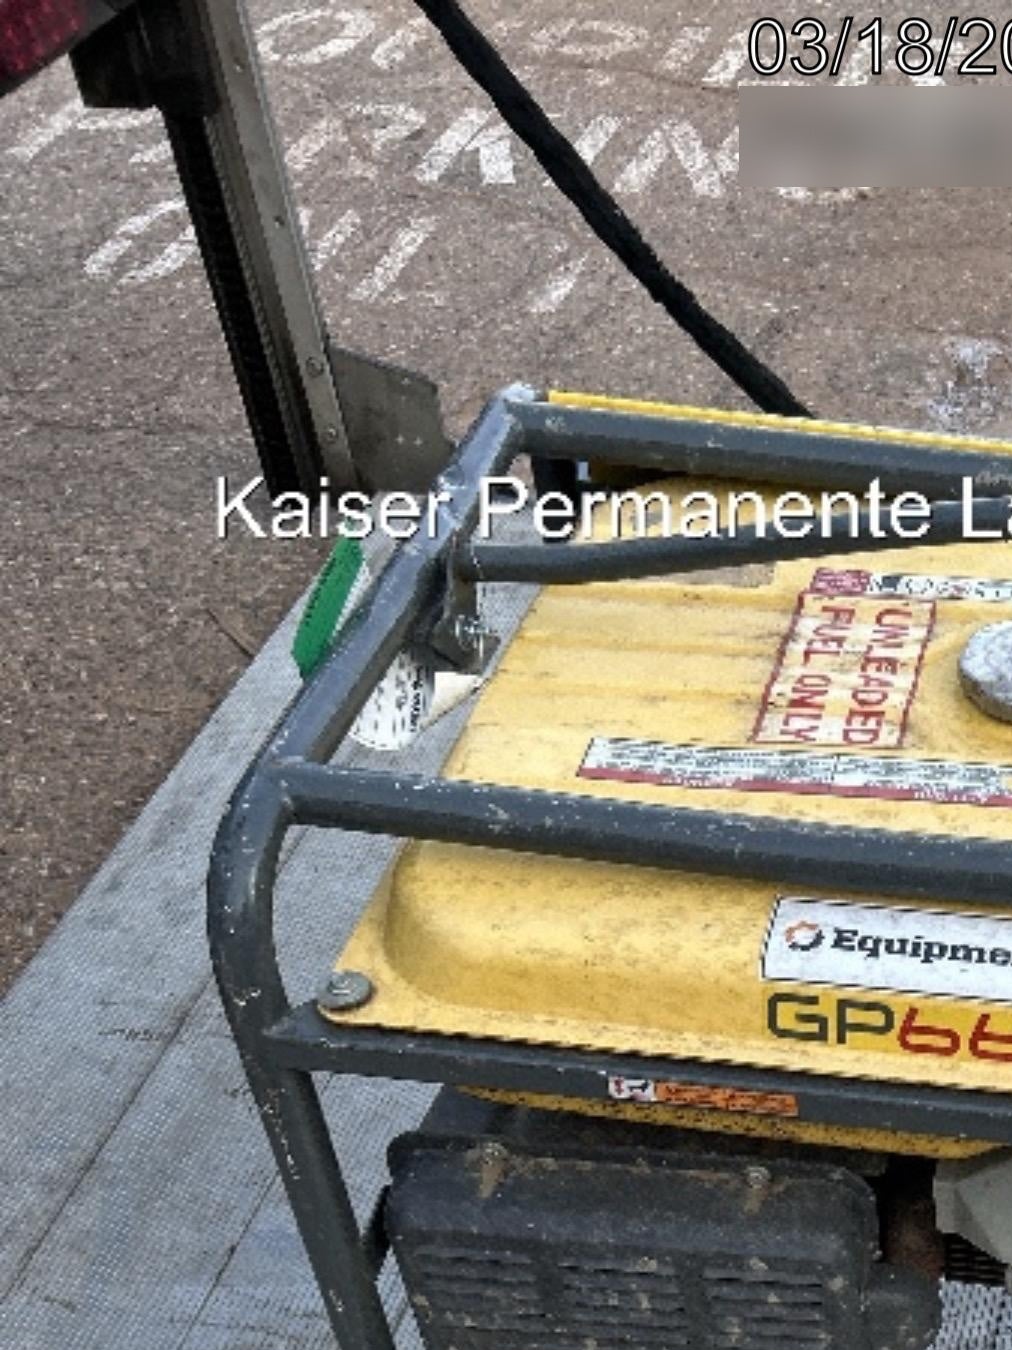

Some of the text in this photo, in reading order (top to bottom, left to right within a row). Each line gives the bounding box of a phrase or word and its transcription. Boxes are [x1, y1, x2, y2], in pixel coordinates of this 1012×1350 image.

[802, 605, 856, 665] FUEL
[779, 673, 832, 742] ONLY
[842, 607, 913, 745] UNLEADED
